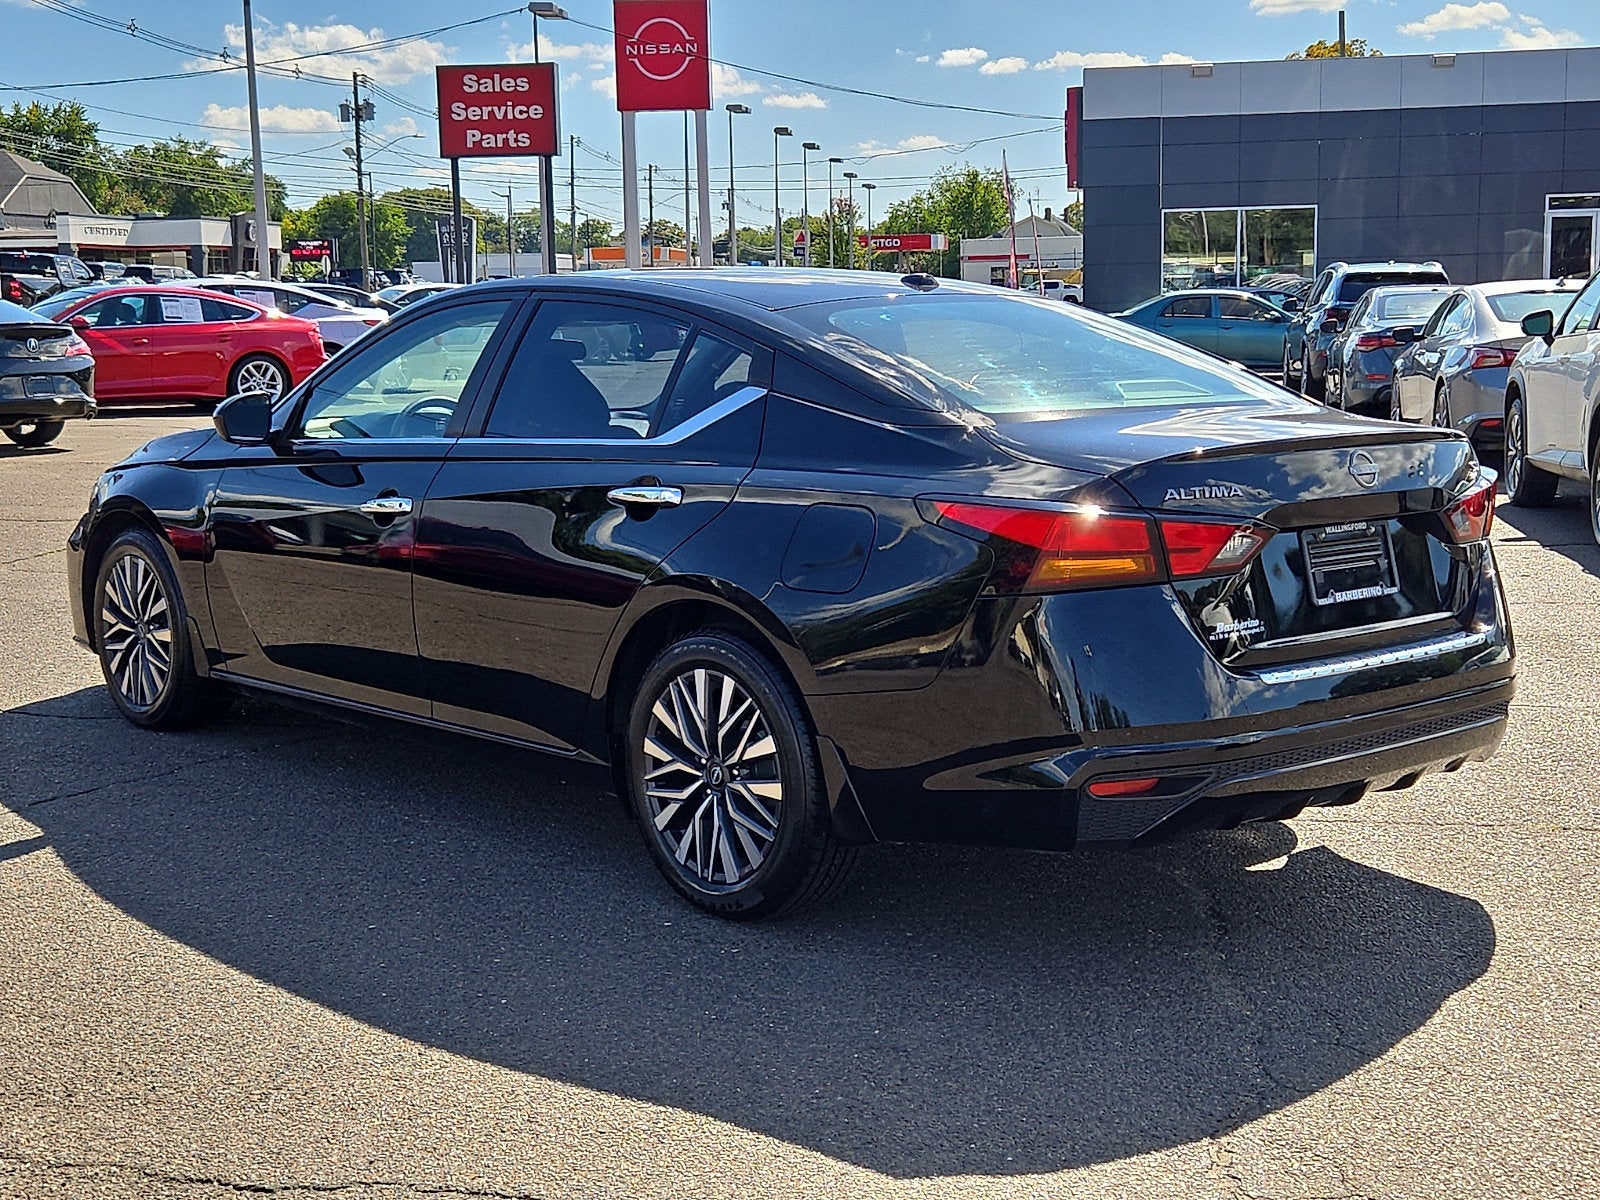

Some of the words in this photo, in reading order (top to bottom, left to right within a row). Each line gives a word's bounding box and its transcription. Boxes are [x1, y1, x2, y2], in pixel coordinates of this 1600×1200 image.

[625, 42, 698, 55] NISSAN
[462, 73, 530, 93] Sales
[450, 101, 544, 121] Service
[466, 129, 531, 148] Parts
[84, 226, 129, 237] CERTIFIED
[1163, 485, 1244, 501] ALTIMA
[1324, 521, 1368, 534] WALLINGFORD
[1335, 585, 1383, 603] BARBERINO
[1216, 617, 1260, 633] Barberino
